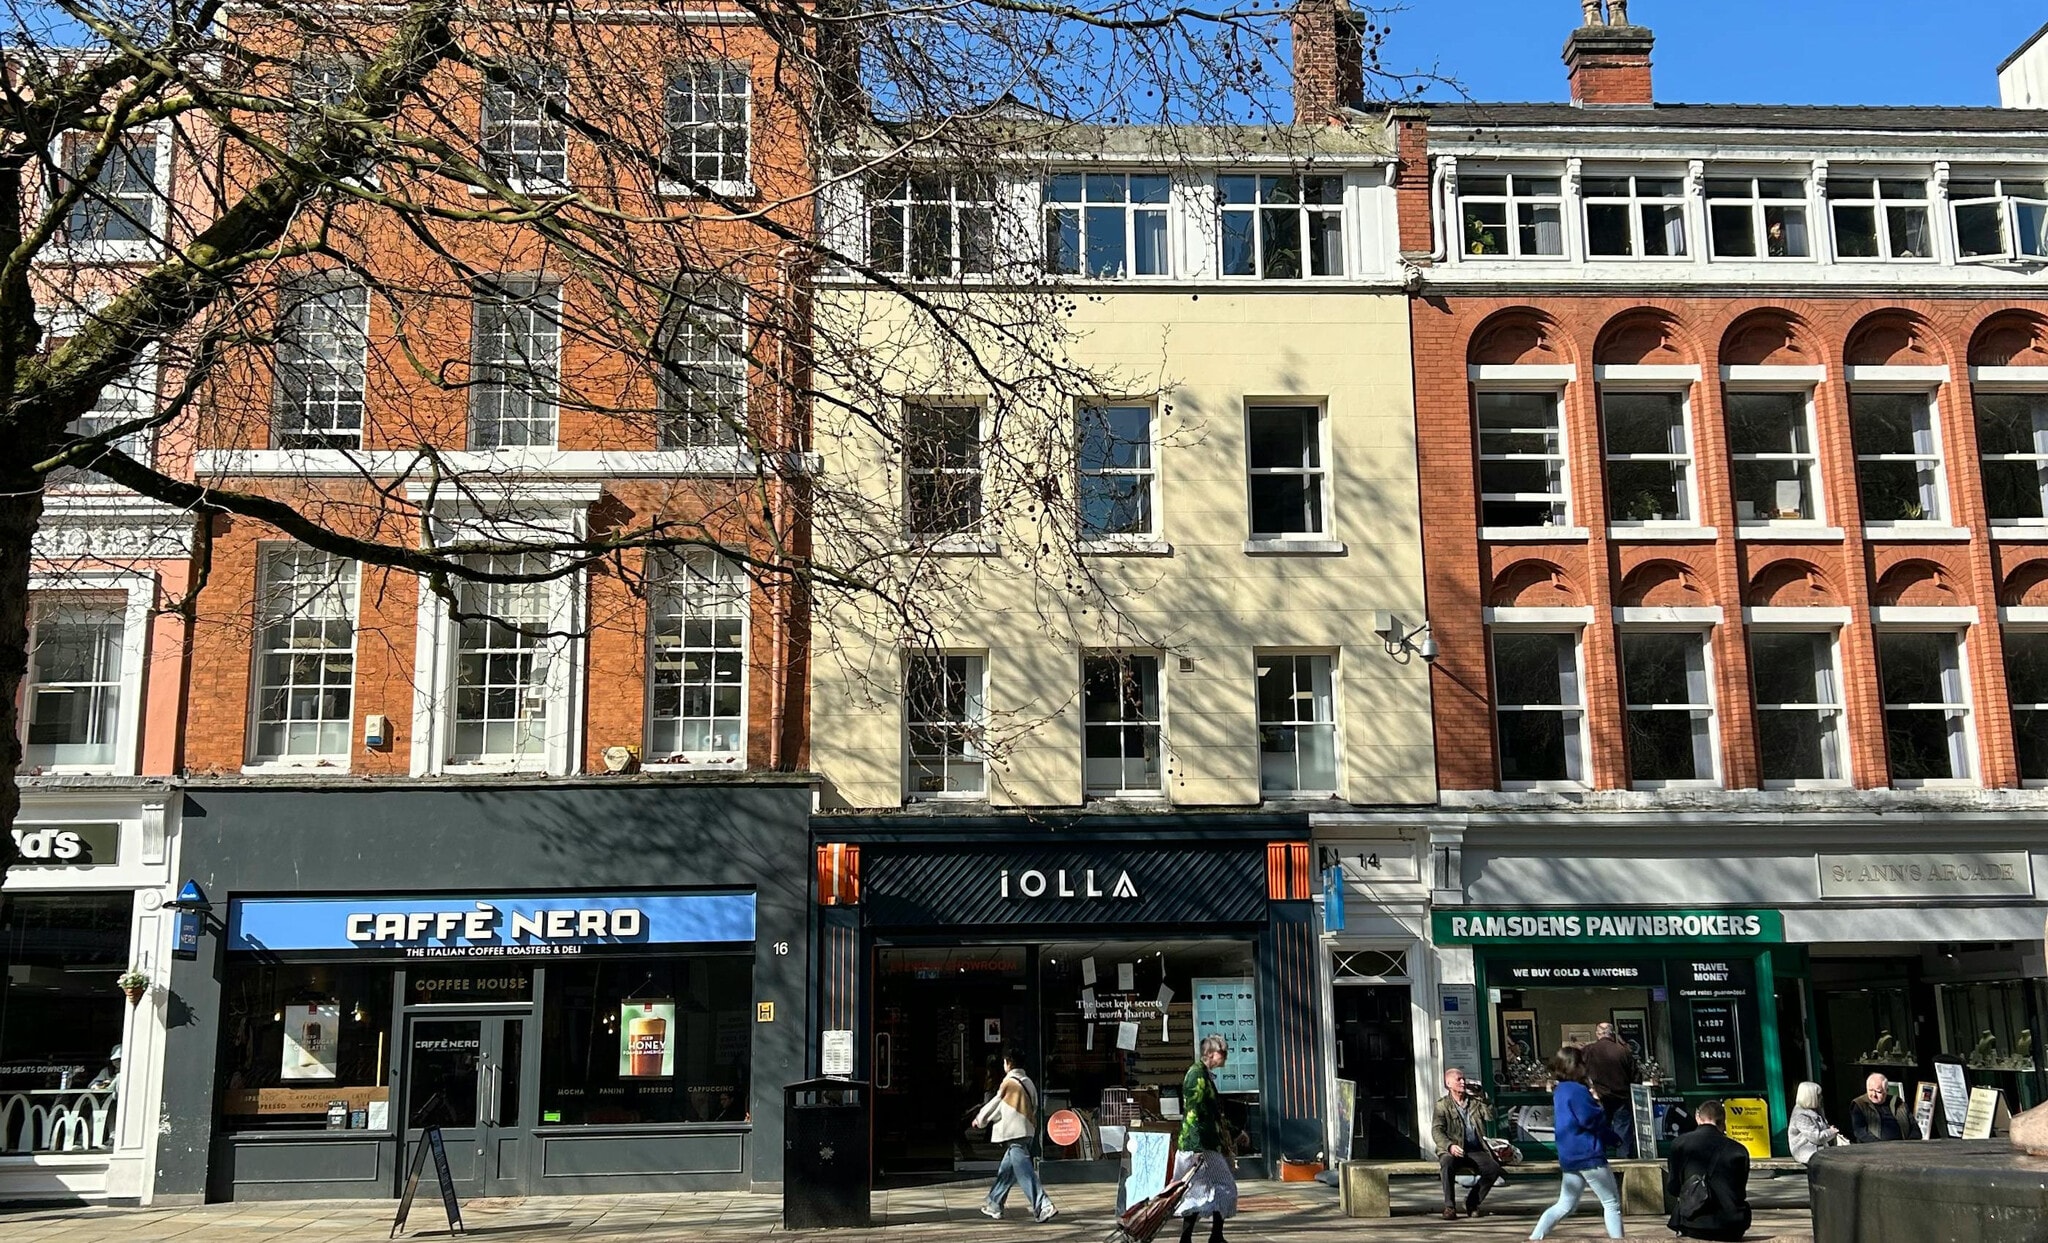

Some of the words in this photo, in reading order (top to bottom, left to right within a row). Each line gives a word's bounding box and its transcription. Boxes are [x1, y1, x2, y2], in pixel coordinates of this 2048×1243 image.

[1357, 853, 1379, 868] 14
[1832, 865, 1853, 882] St
[1858, 864, 1922, 882] ANN'S
[1927, 863, 2015, 881] ARCADE
[346, 900, 494, 941] CAFFÈ
[511, 909, 641, 939] NERO
[1452, 916, 1581, 937] RAMSDENS
[1587, 915, 1761, 936] PAWNBROKERS
[406, 948, 425, 957] THE
[427, 947, 466, 957] ITALIAN
[468, 946, 505, 956] COFFEE
[507, 945, 552, 955] ROASTERS
[553, 946, 560, 954] &
[562, 945, 581, 954] DELI
[773, 942, 788, 955] 16
[1692, 963, 1729, 971] TRAVEL
[1513, 968, 1529, 977] WE
[1531, 968, 1551, 977] BUY
[1553, 968, 1580, 977] GOLD
[1582, 968, 1590, 977] &
[1592, 968, 1638, 977] WATCHES
[1694, 973, 1729, 981] MONEY
[415, 979, 470, 991] COFFEE
[477, 977, 526, 990] HOUSE
[1076, 1000, 1093, 1009] The
[1095, 999, 1112, 1008] best
[1114, 999, 1132, 1010] kept
[1134, 999, 1163, 1008] secrets
[1099, 1010, 1122, 1019] worth
[1125, 1009, 1156, 1019] sharing
[415, 1038, 448, 1048] CAFFÈ
[449, 1040, 479, 1048] NERO
[628, 1041, 667, 1050] HONEY
[12, 1066, 36, 1074] SEATS
[36, 1065, 85, 1073] DOWNSTAIRS
[557, 1088, 585, 1096] MOCHA
